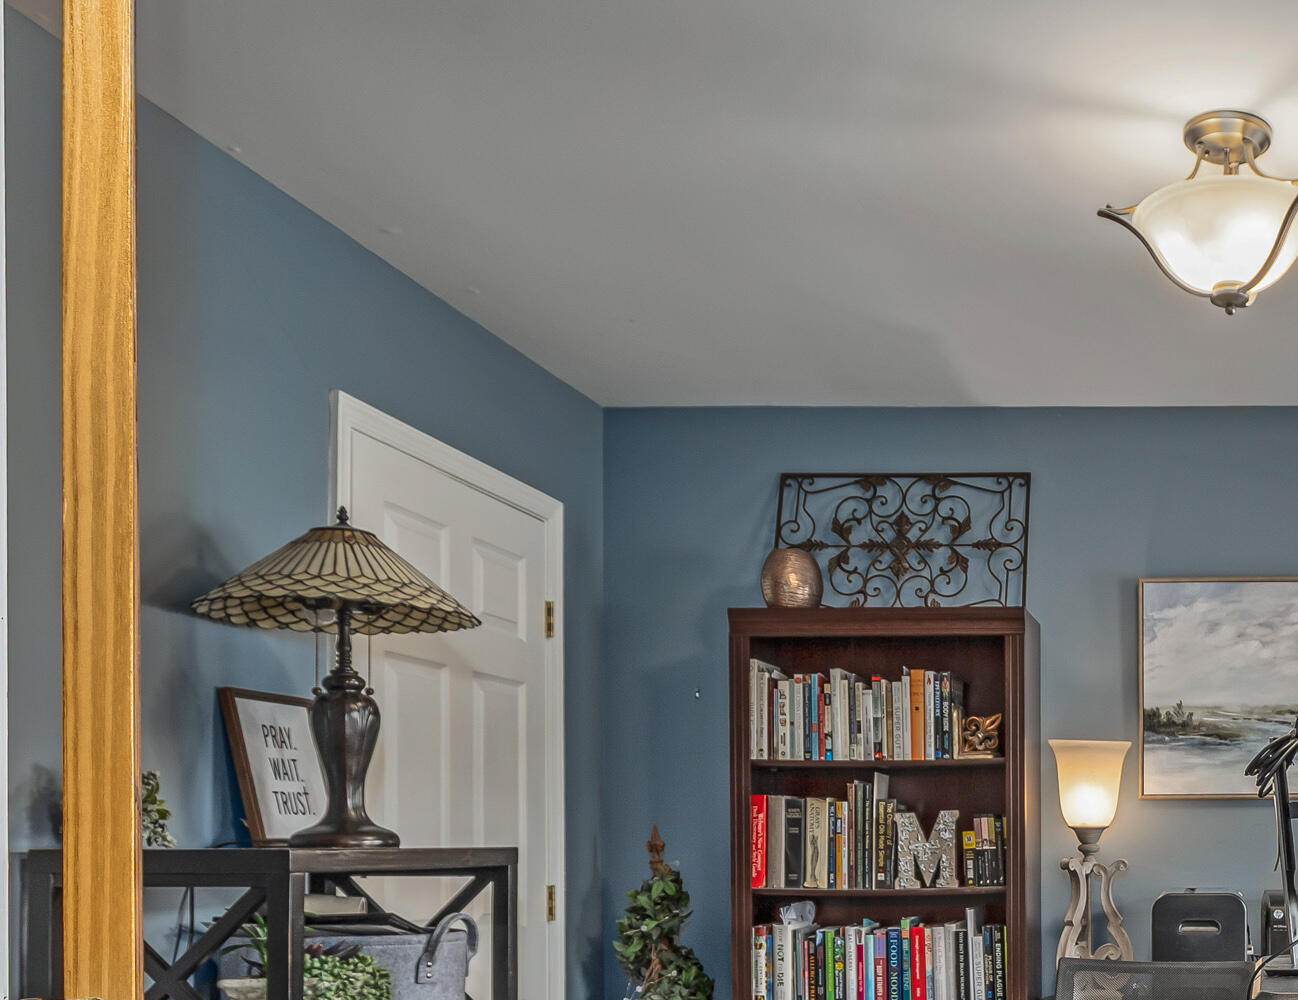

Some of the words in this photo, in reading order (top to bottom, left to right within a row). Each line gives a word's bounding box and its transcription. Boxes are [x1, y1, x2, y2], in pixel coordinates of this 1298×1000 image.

[261, 724, 298, 751] PRAY.
[268, 757, 304, 782] WAIT.
[271, 785, 316, 816] TRUST.
[877, 801, 885, 824] Essential
[885, 802, 894, 813] The
[885, 813, 894, 839] Chemistry
[876, 850, 885, 867] Simple
[893, 809, 961, 890] M
[777, 943, 785, 963] NOT
[890, 939, 898, 967] FOOD
[776, 972, 785, 987] DIE
